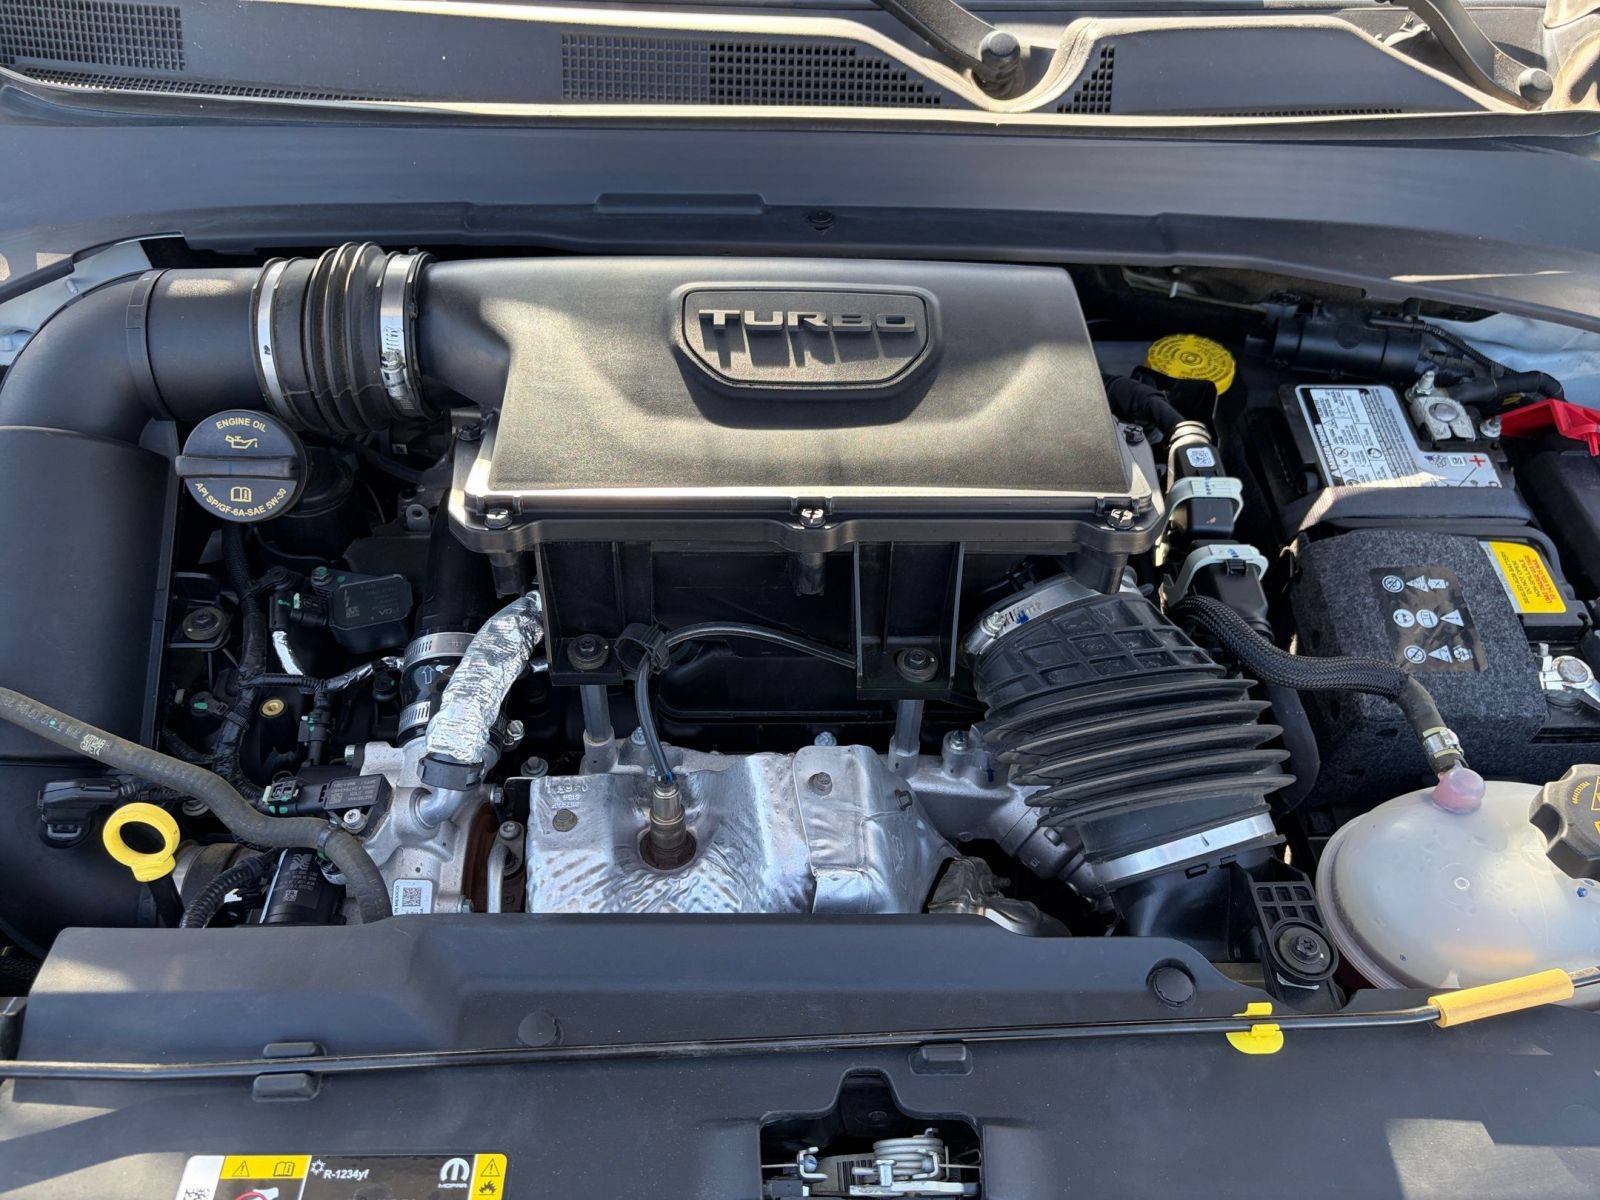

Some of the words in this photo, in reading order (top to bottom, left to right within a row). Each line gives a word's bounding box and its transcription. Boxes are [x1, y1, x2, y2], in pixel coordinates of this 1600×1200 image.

[698, 309, 916, 332] TURBO
[216, 417, 251, 430] ENGINE
[252, 420, 266, 432] OIL
[195, 483, 209, 497] API
[265, 488, 287, 509] 5W-30
[323, 1169, 369, 1181] R-1234yf
